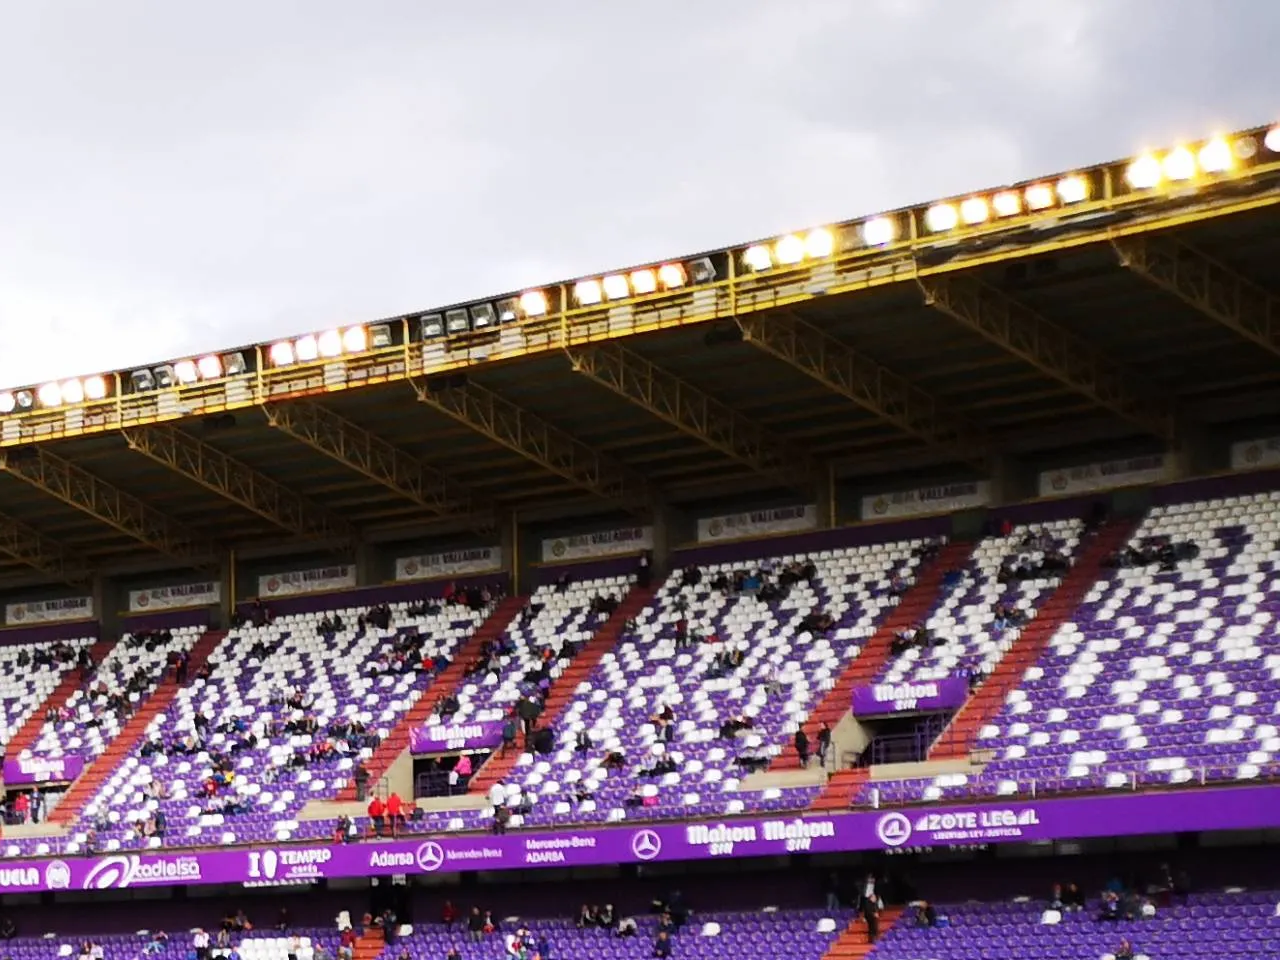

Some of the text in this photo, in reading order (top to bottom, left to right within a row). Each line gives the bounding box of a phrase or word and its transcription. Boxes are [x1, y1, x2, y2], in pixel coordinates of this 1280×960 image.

[915, 809, 1040, 832] AZOTE LEGAL
[370, 851, 414, 867] Adarsa
